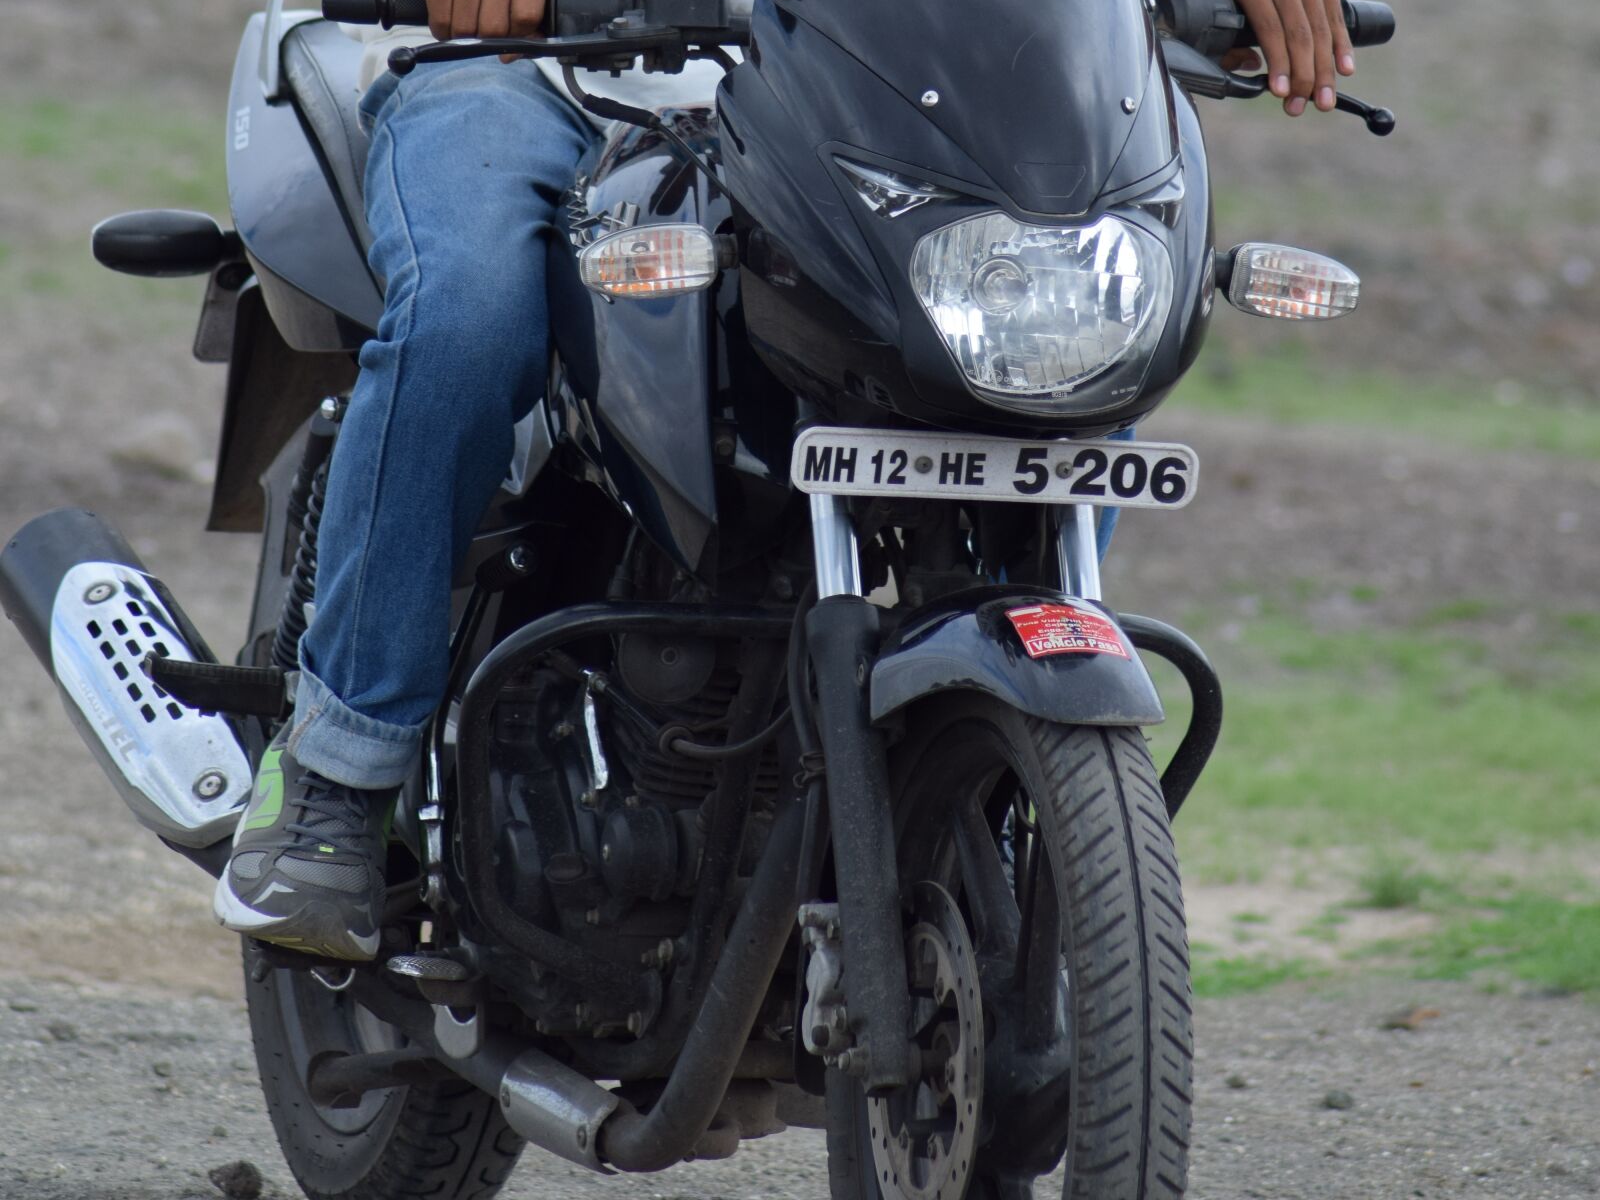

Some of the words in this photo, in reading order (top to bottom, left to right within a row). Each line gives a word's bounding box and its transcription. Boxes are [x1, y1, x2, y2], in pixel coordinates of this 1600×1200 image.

[234, 106, 251, 151] 150
[803, 445, 858, 483] MH
[871, 449, 908, 485] 12
[938, 452, 987, 486] HE
[1033, 638, 1086, 651] Vehicle
[1088, 639, 1121, 653] Pass
